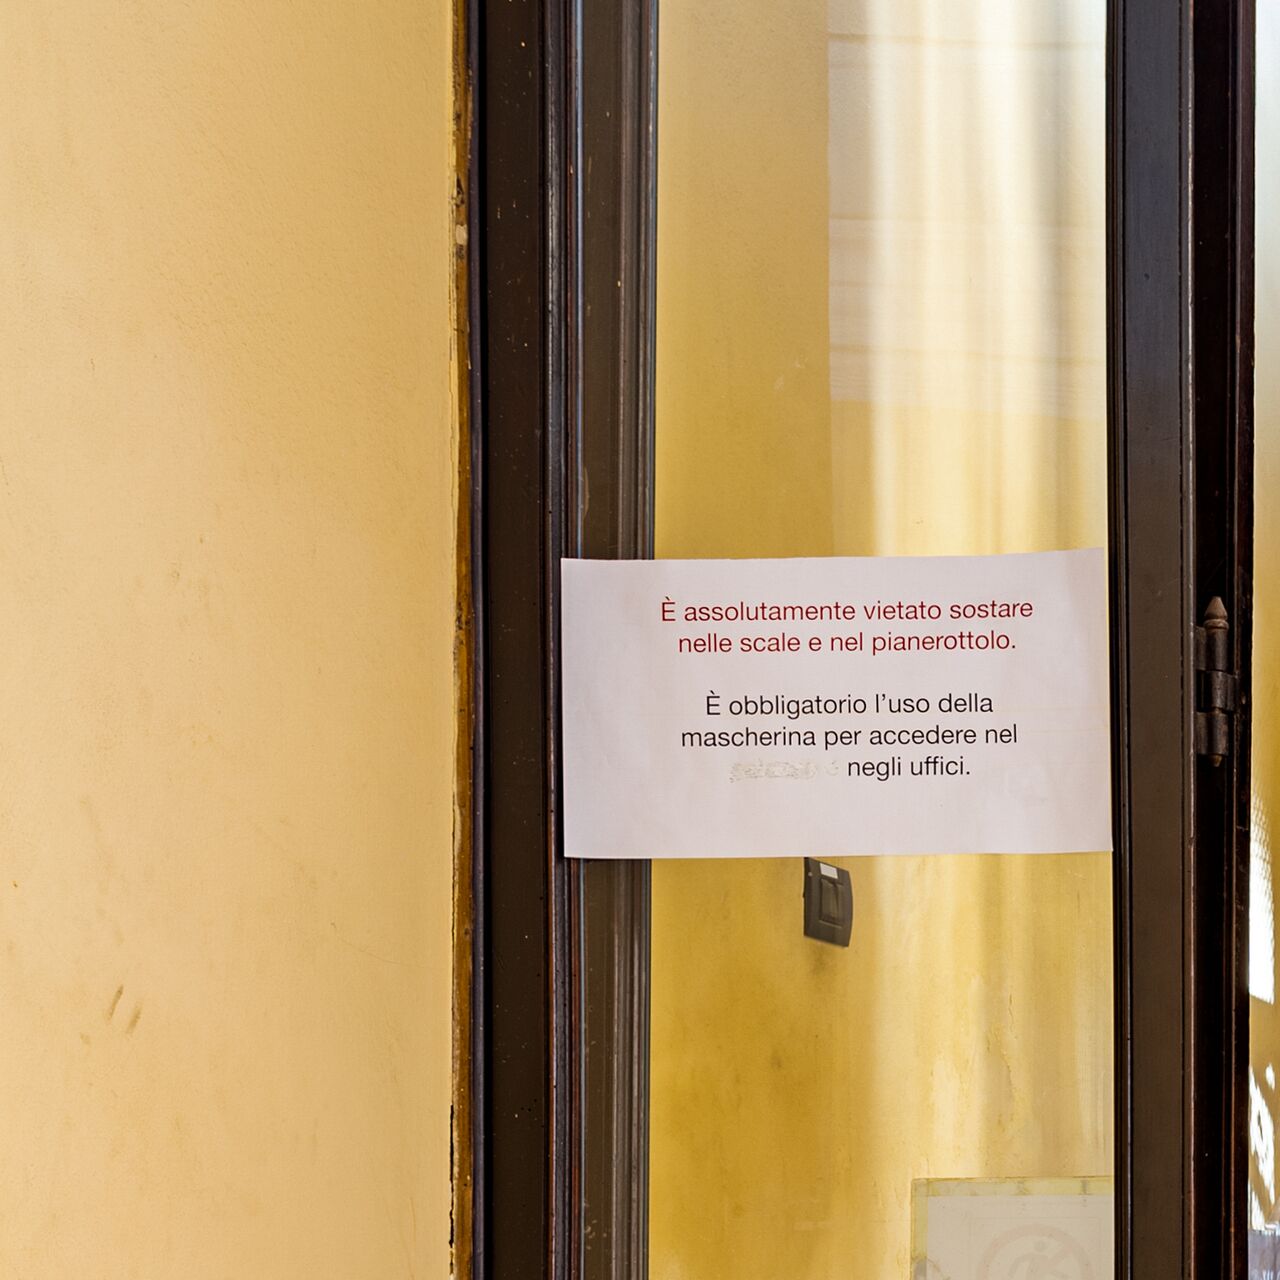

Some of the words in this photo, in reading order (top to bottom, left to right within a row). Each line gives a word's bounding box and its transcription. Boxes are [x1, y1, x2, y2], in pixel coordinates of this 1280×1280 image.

[661, 595, 677, 622] È
[683, 600, 856, 622] assolutamente
[863, 599, 942, 621] vietato
[949, 599, 1034, 620] sostare
[678, 632, 733, 653] nelle
[739, 631, 801, 653] scale
[808, 636, 823, 652] e
[830, 631, 864, 652] nel
[872, 629, 1016, 656] pianerottolo.
[706, 689, 721, 716] È
[728, 693, 867, 721] obbligatorio
[937, 692, 994, 714] della
[681, 725, 817, 748] mascherina
[824, 729, 863, 751] per
[869, 724, 977, 746] accedere
[985, 723, 1018, 744] nel
[847, 756, 902, 782] negli
[910, 755, 971, 777] uffici.
